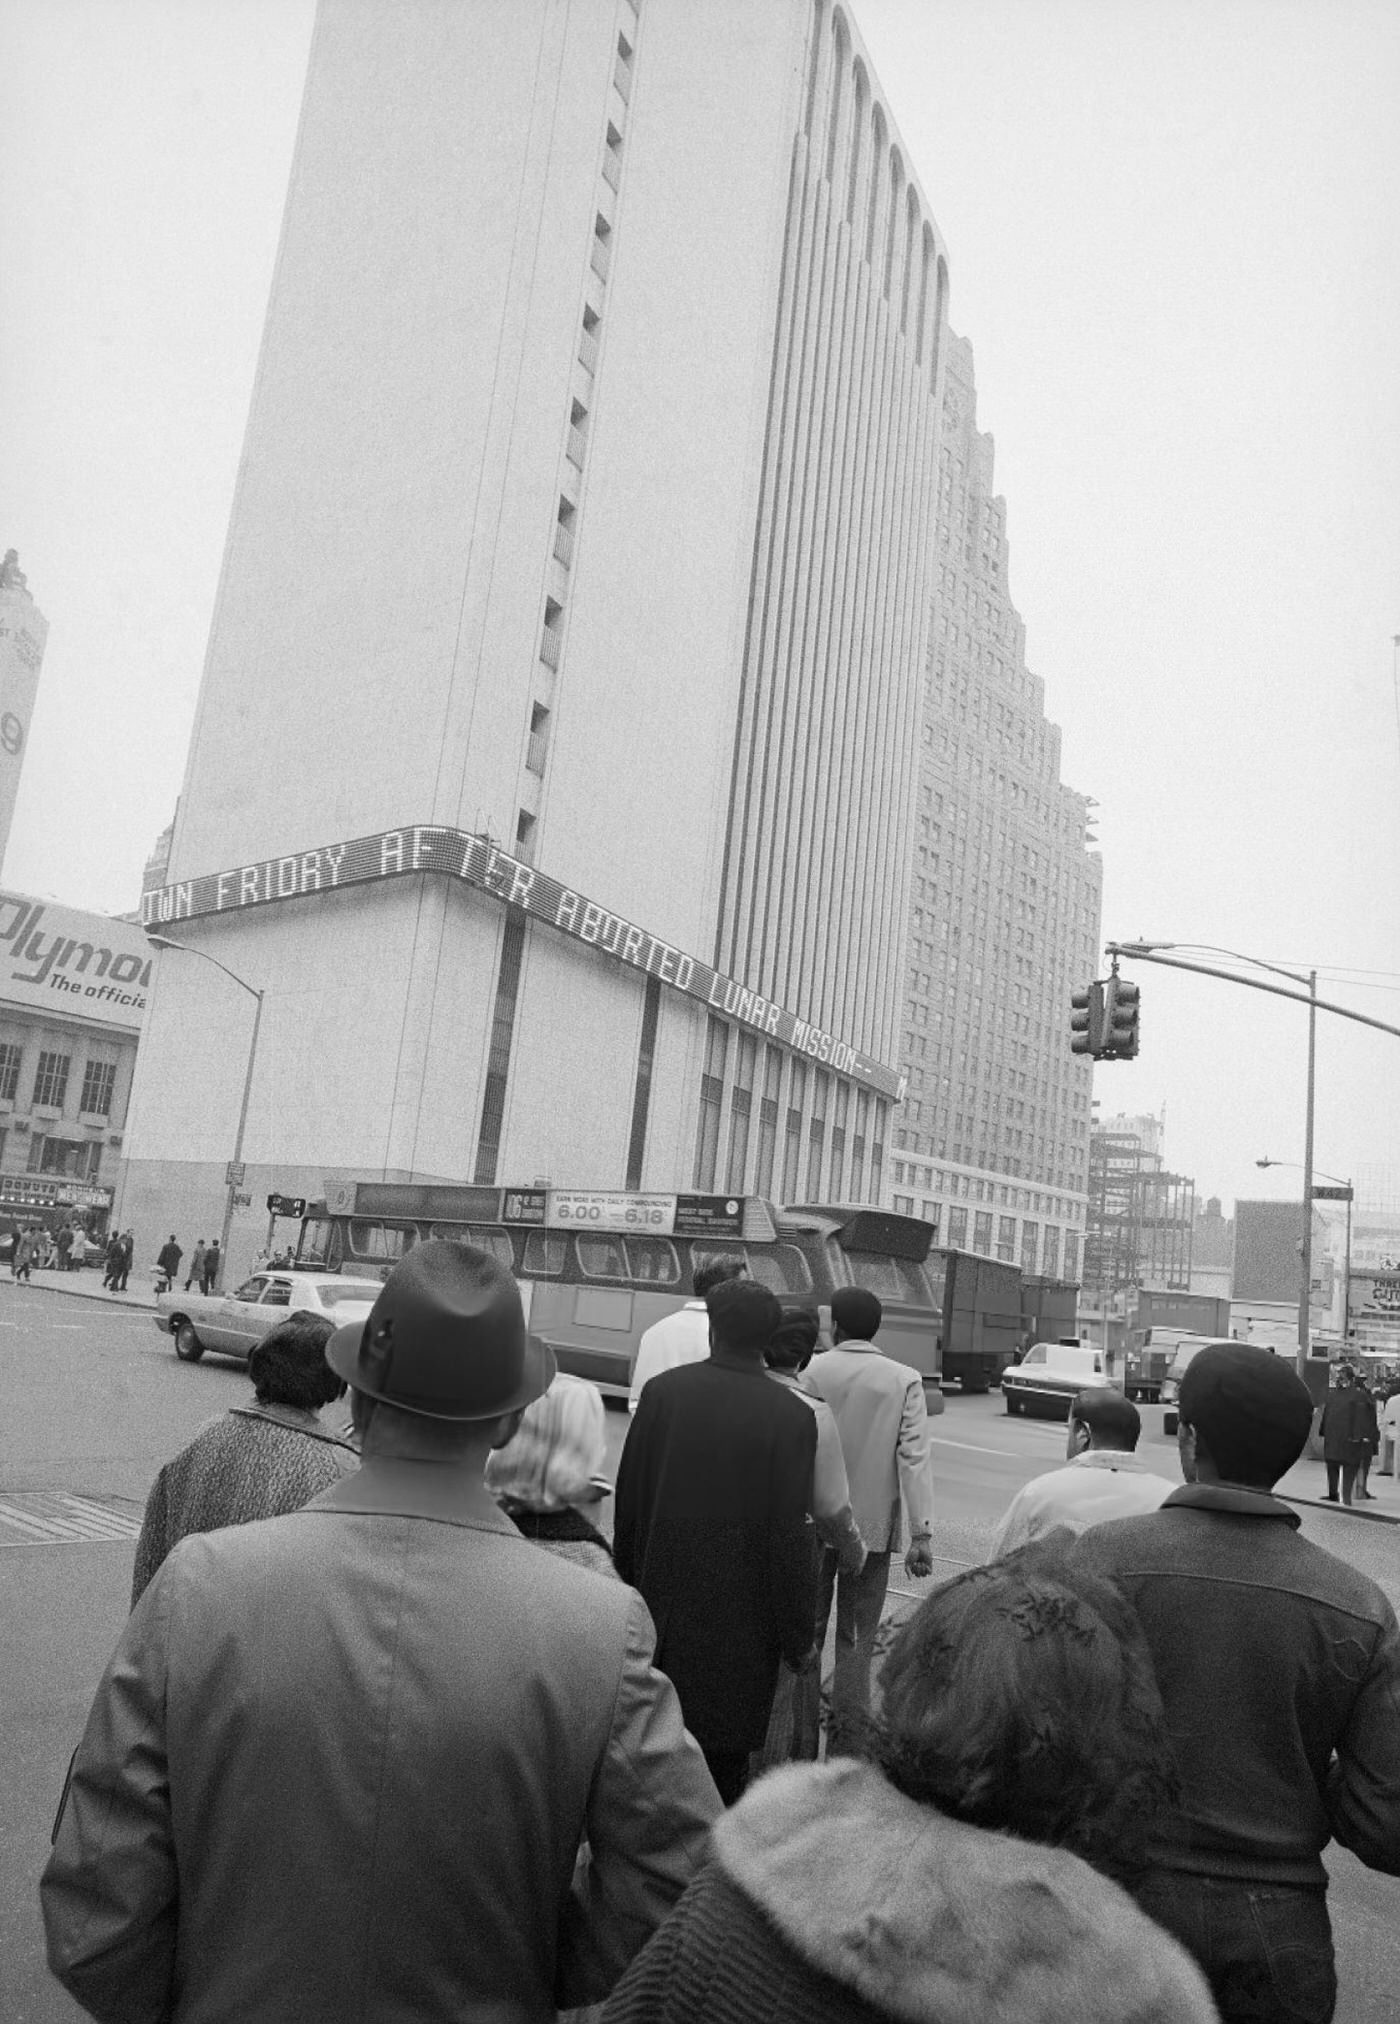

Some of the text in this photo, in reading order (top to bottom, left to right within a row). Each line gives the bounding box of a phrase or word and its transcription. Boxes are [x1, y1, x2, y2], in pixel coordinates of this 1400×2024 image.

[217, 845, 346, 910] FRIDAY
[381, 827, 535, 908] AFTER
[555, 890, 695, 990] ABORTED
[708, 973, 781, 1036] LUNAR
[50, 973, 82, 995] The
[558, 1204, 601, 1220] 6.00
[624, 1208, 663, 1225] 6.18
